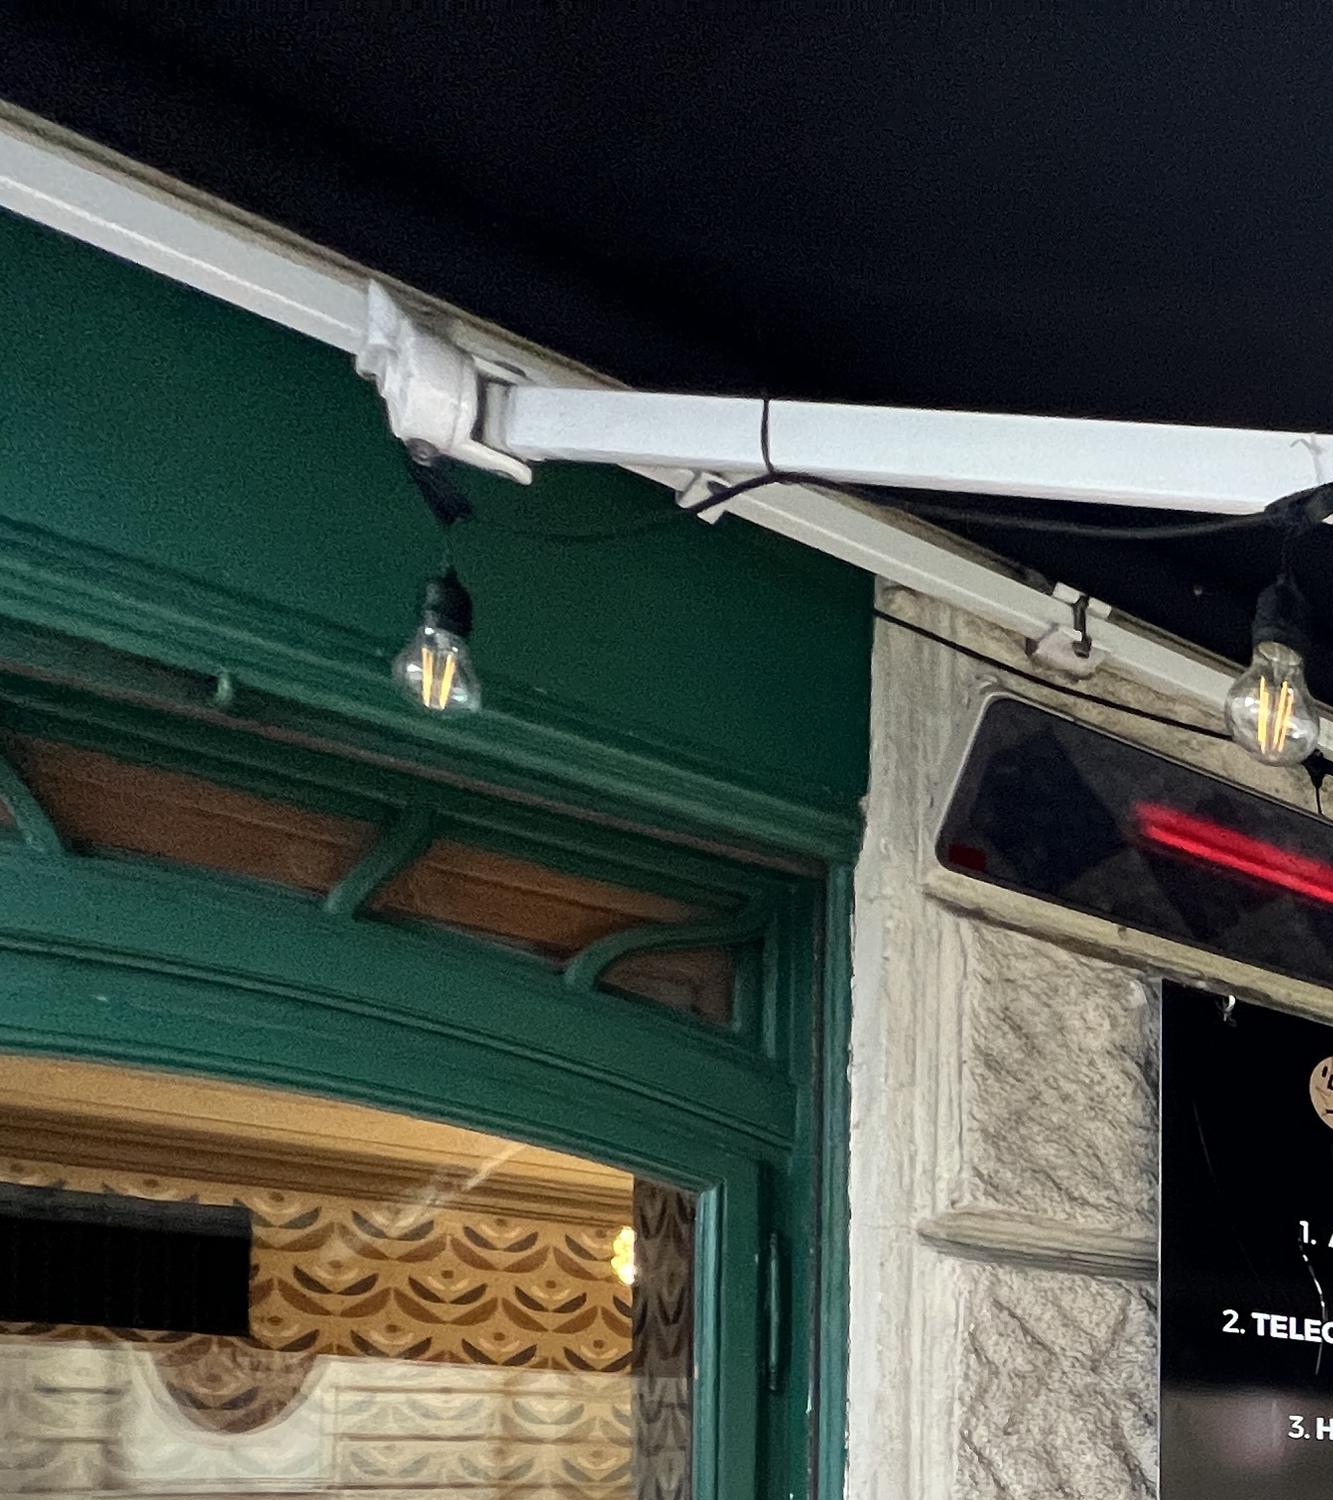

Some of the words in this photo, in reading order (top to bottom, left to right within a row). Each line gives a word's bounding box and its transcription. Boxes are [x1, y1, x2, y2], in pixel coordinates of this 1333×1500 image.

[1299, 1220, 1317, 1245] 1.
[1222, 1309, 1246, 1335] 2.
[1287, 1415, 1311, 1439] 3.
